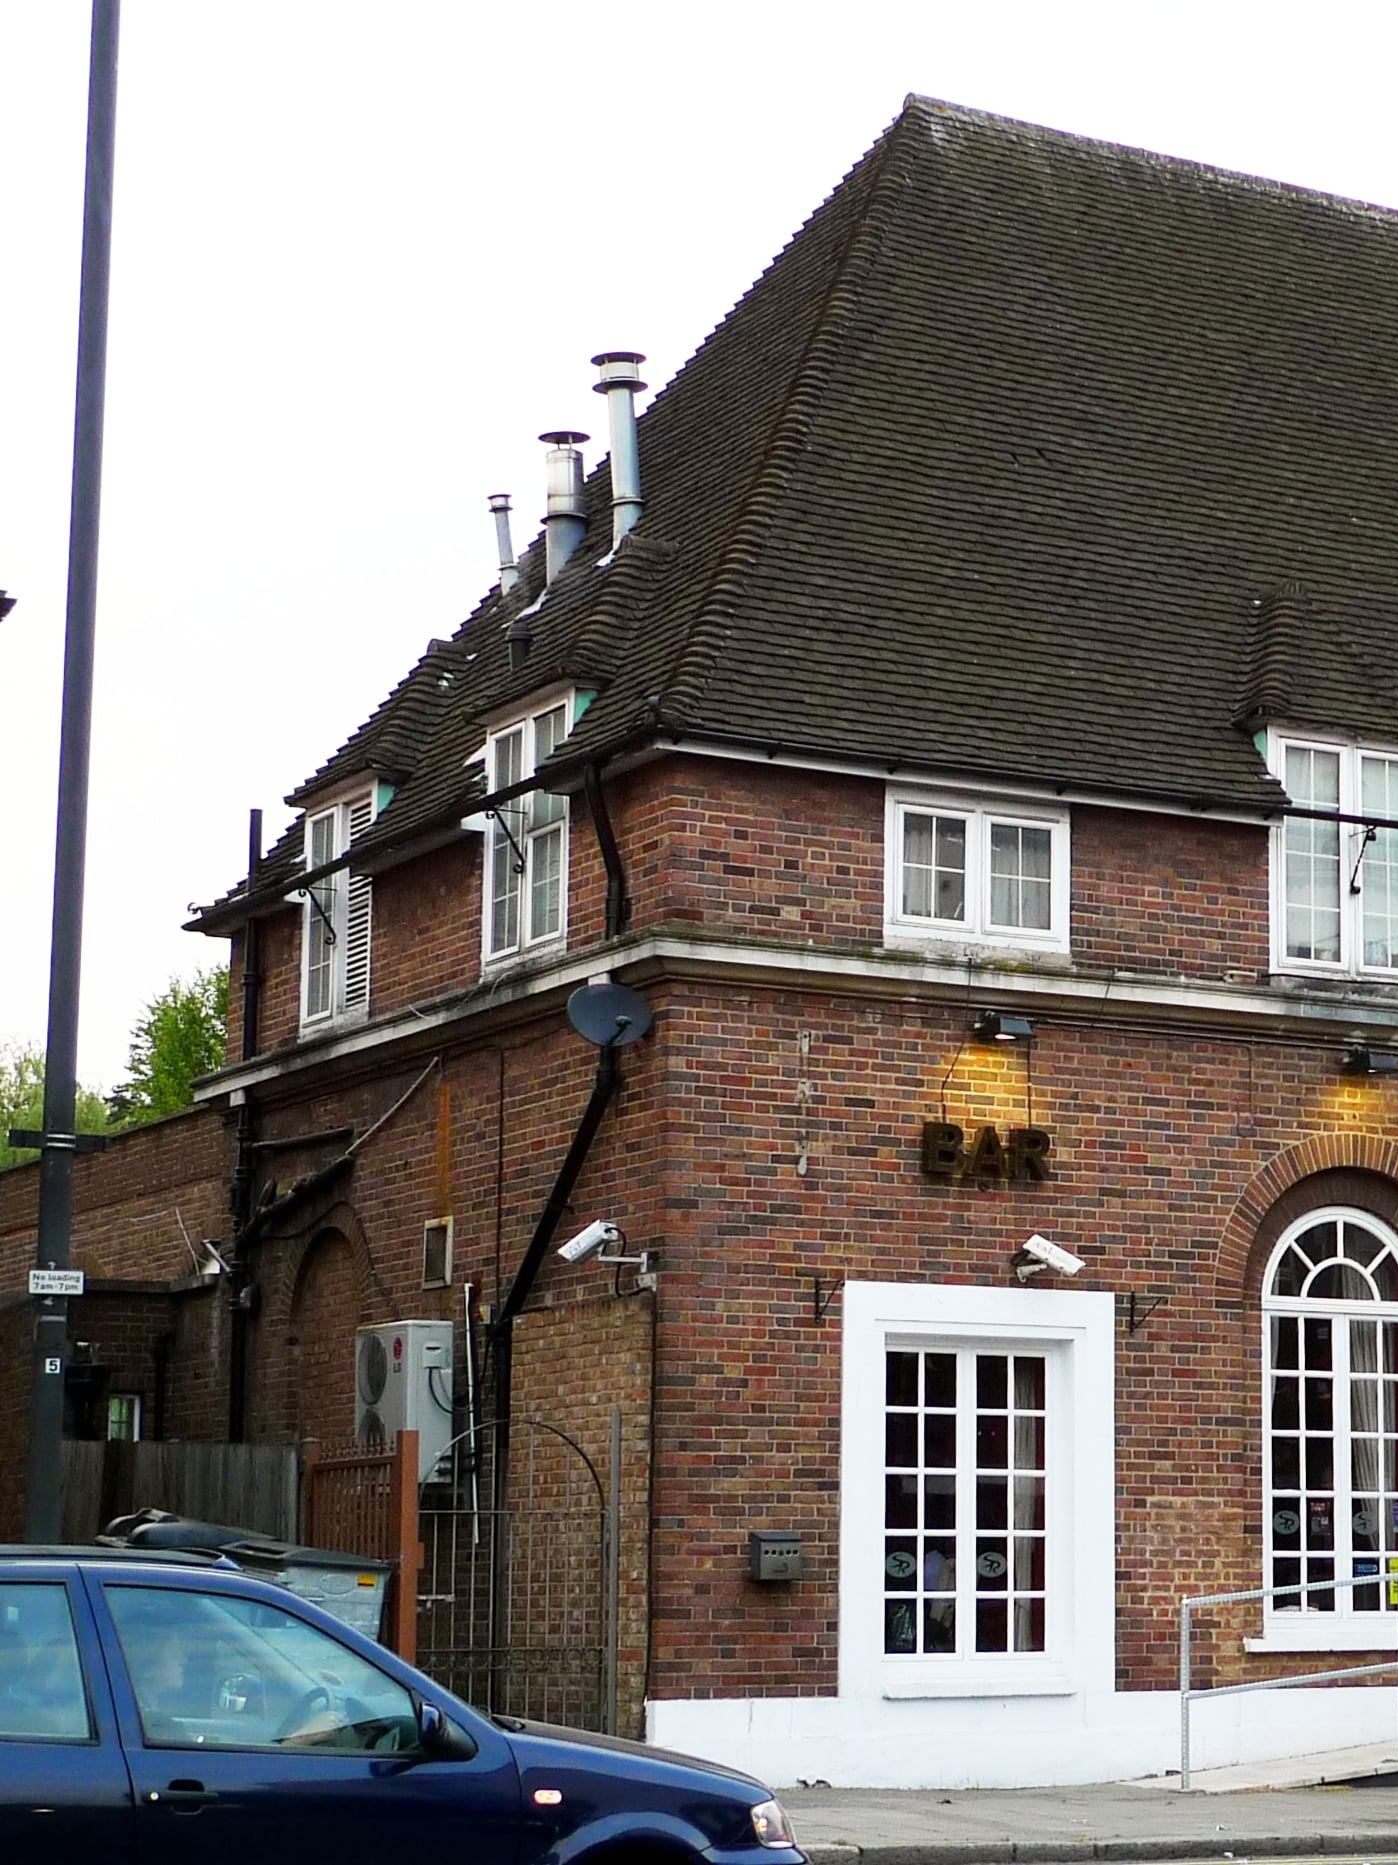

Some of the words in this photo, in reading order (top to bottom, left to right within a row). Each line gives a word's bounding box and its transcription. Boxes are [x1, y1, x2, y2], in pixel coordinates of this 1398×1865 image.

[922, 1121, 1051, 1181] BAR
[32, 1273, 46, 1281] No
[49, 1360, 58, 1372] 5
[393, 1362, 402, 1374] LG
